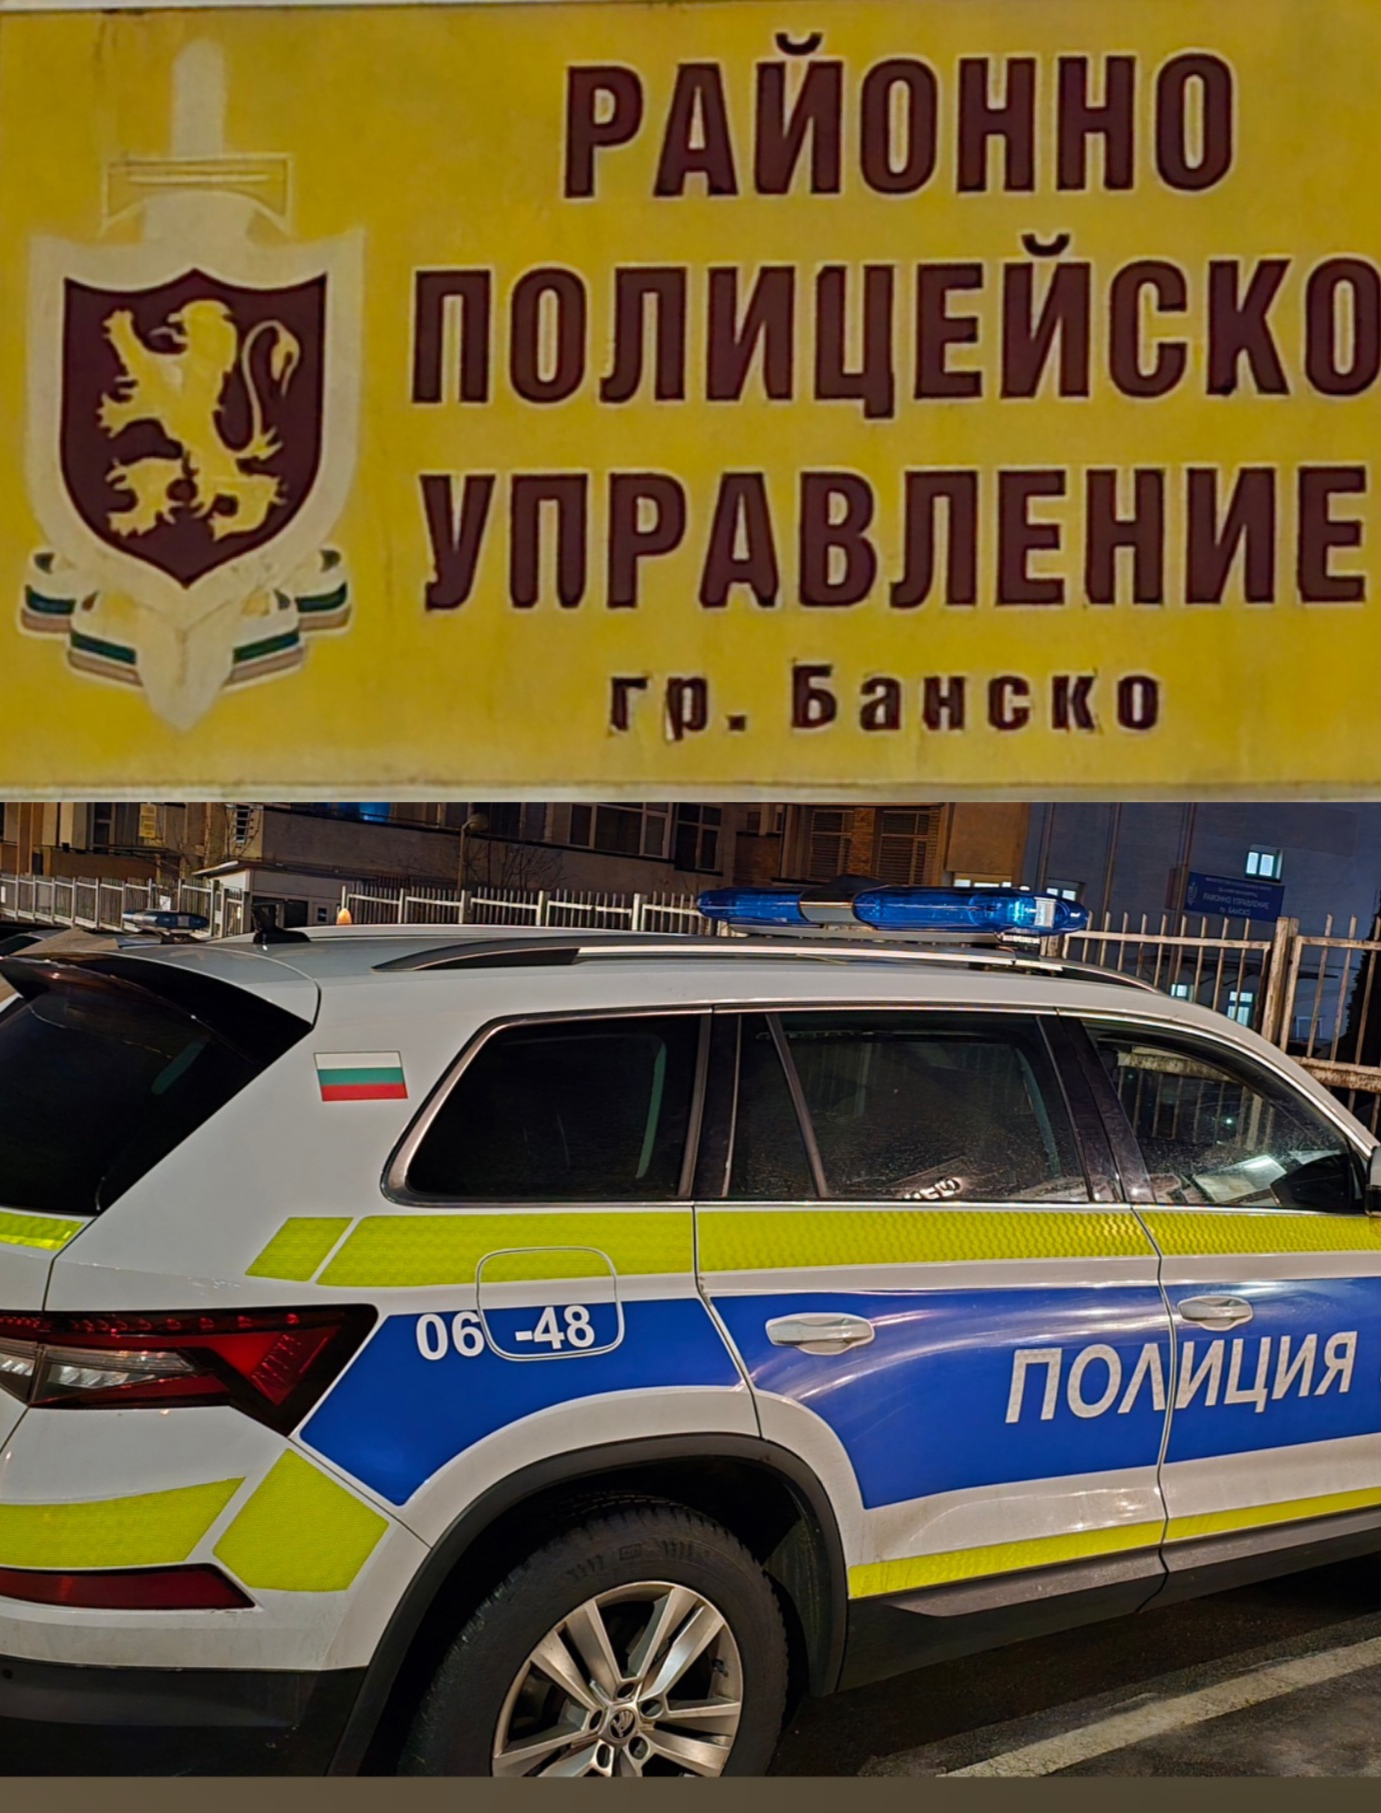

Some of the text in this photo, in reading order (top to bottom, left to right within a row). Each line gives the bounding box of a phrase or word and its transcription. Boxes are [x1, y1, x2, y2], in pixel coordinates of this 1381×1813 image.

[564, 32, 1233, 198] РАЙОННО
[412, 233, 1381, 420] ПОЛИЦЕЙСКО
[419, 466, 1367, 612] УПРАВЛЕНИЕ
[608, 662, 1161, 740] гр. Банско
[1005, 1331, 1358, 1424] ПОЛИЦИЯ
